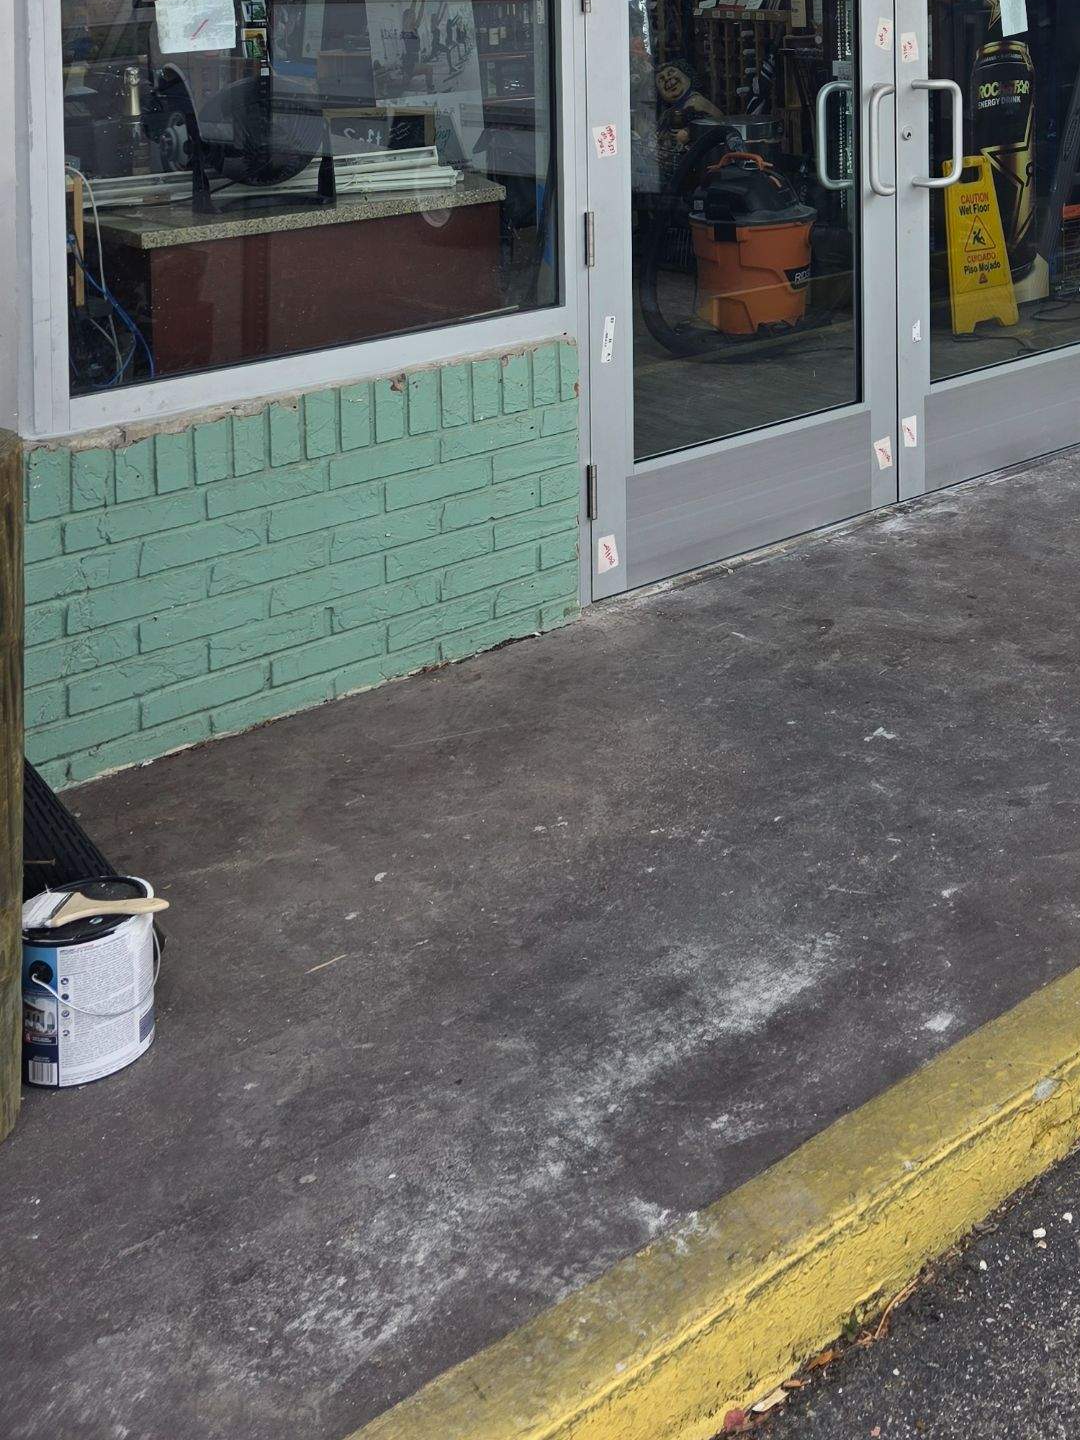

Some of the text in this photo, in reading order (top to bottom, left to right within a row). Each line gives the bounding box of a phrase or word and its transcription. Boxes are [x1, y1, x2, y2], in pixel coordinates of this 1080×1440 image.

[977, 96, 1021, 109] ENERGY DRINK
[960, 192, 989, 205] CAUTION
[959, 203, 990, 216] Wet Floor
[966, 252, 996, 263] CUIDADO
[963, 261, 1001, 275] Piso Mojado
